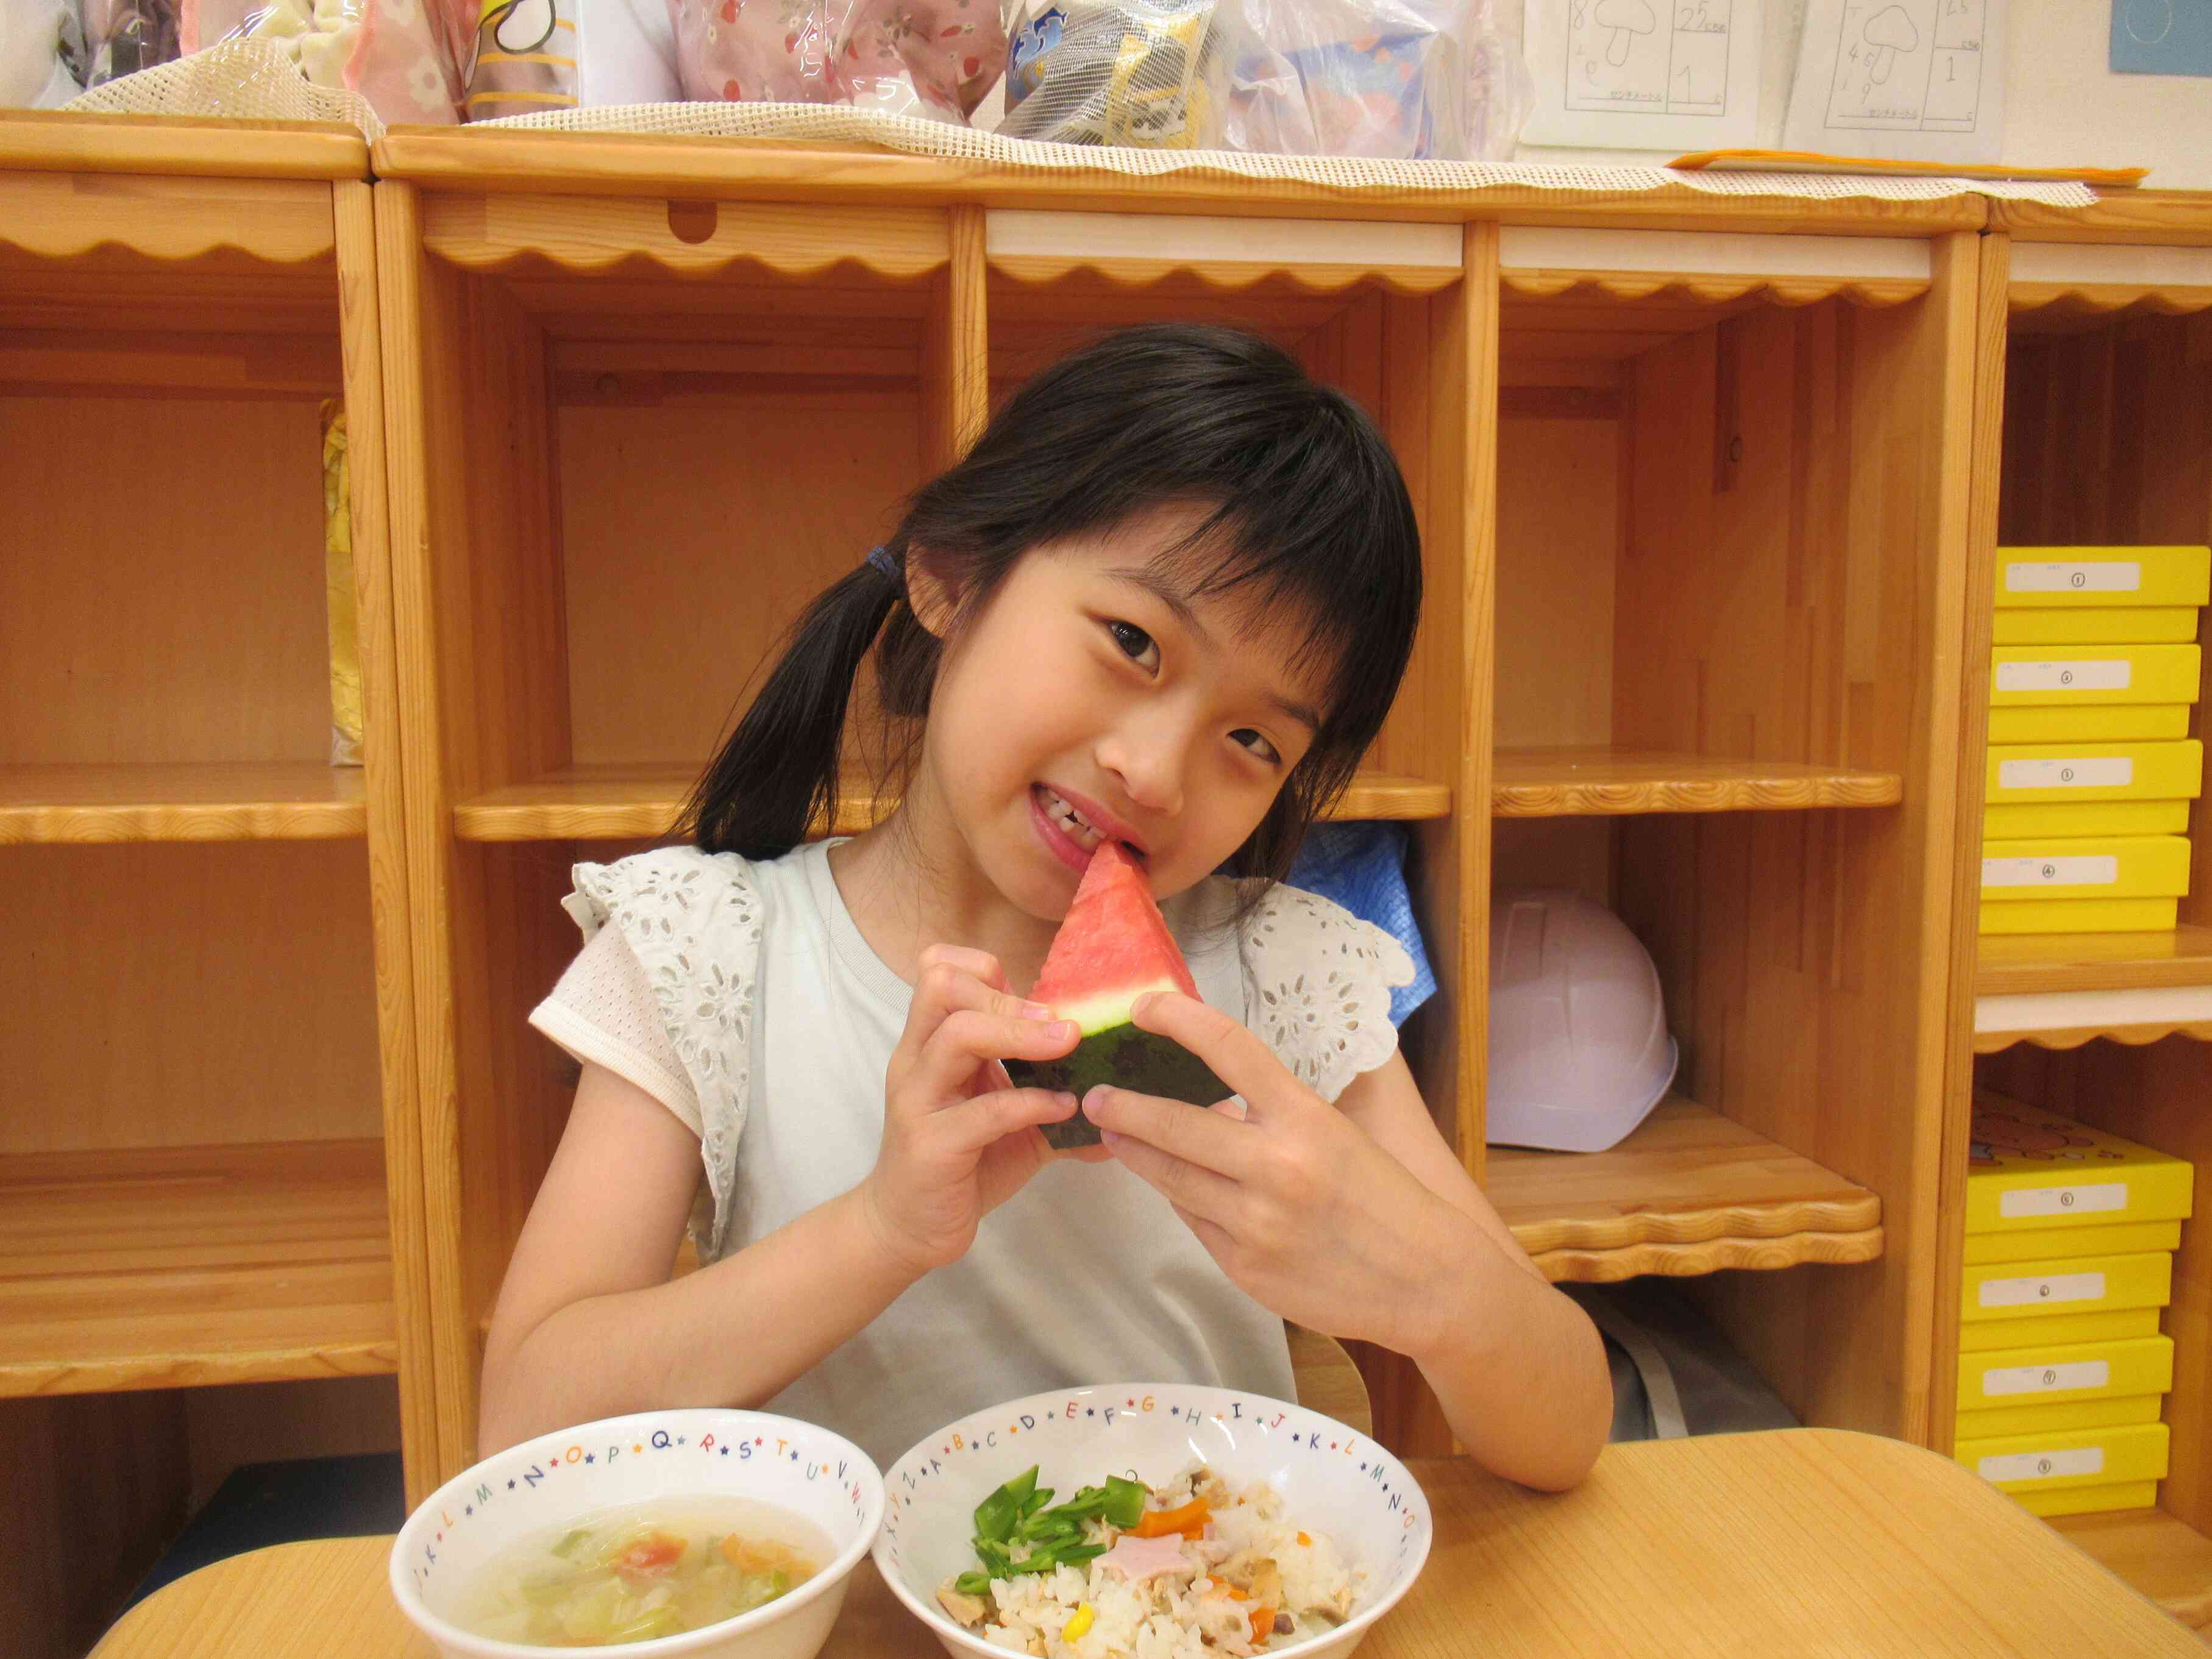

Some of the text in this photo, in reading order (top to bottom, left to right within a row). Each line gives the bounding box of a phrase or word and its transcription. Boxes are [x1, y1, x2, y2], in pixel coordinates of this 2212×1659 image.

[443, 1512, 454, 1527] L
[476, 1483, 493, 1506] M
[524, 1465, 545, 1488] N
[566, 1445, 583, 1464] O
[608, 1447, 619, 1463] P
[651, 1430, 673, 1449] Q
[699, 1433, 716, 1453] R
[739, 1441, 752, 1460] S
[776, 1438, 790, 1456] T
[806, 1462, 819, 1480] U
[838, 1459, 848, 1479] V
[930, 1458, 941, 1474] A
[953, 1433, 964, 1450] B
[986, 1431, 997, 1448] C
[1019, 1415, 1035, 1430] D
[1065, 1401, 1078, 1419] E
[1104, 1407, 1115, 1426] F
[1142, 1395, 1155, 1412] G
[1186, 1408, 1201, 1426] H
[1231, 1402, 1242, 1419] I
[1270, 1413, 1286, 1428] J
[1309, 1433, 1321, 1449] K
[1344, 1439, 1355, 1455] L
[1370, 1463, 1385, 1482] M
[1387, 1493, 1401, 1511] N
